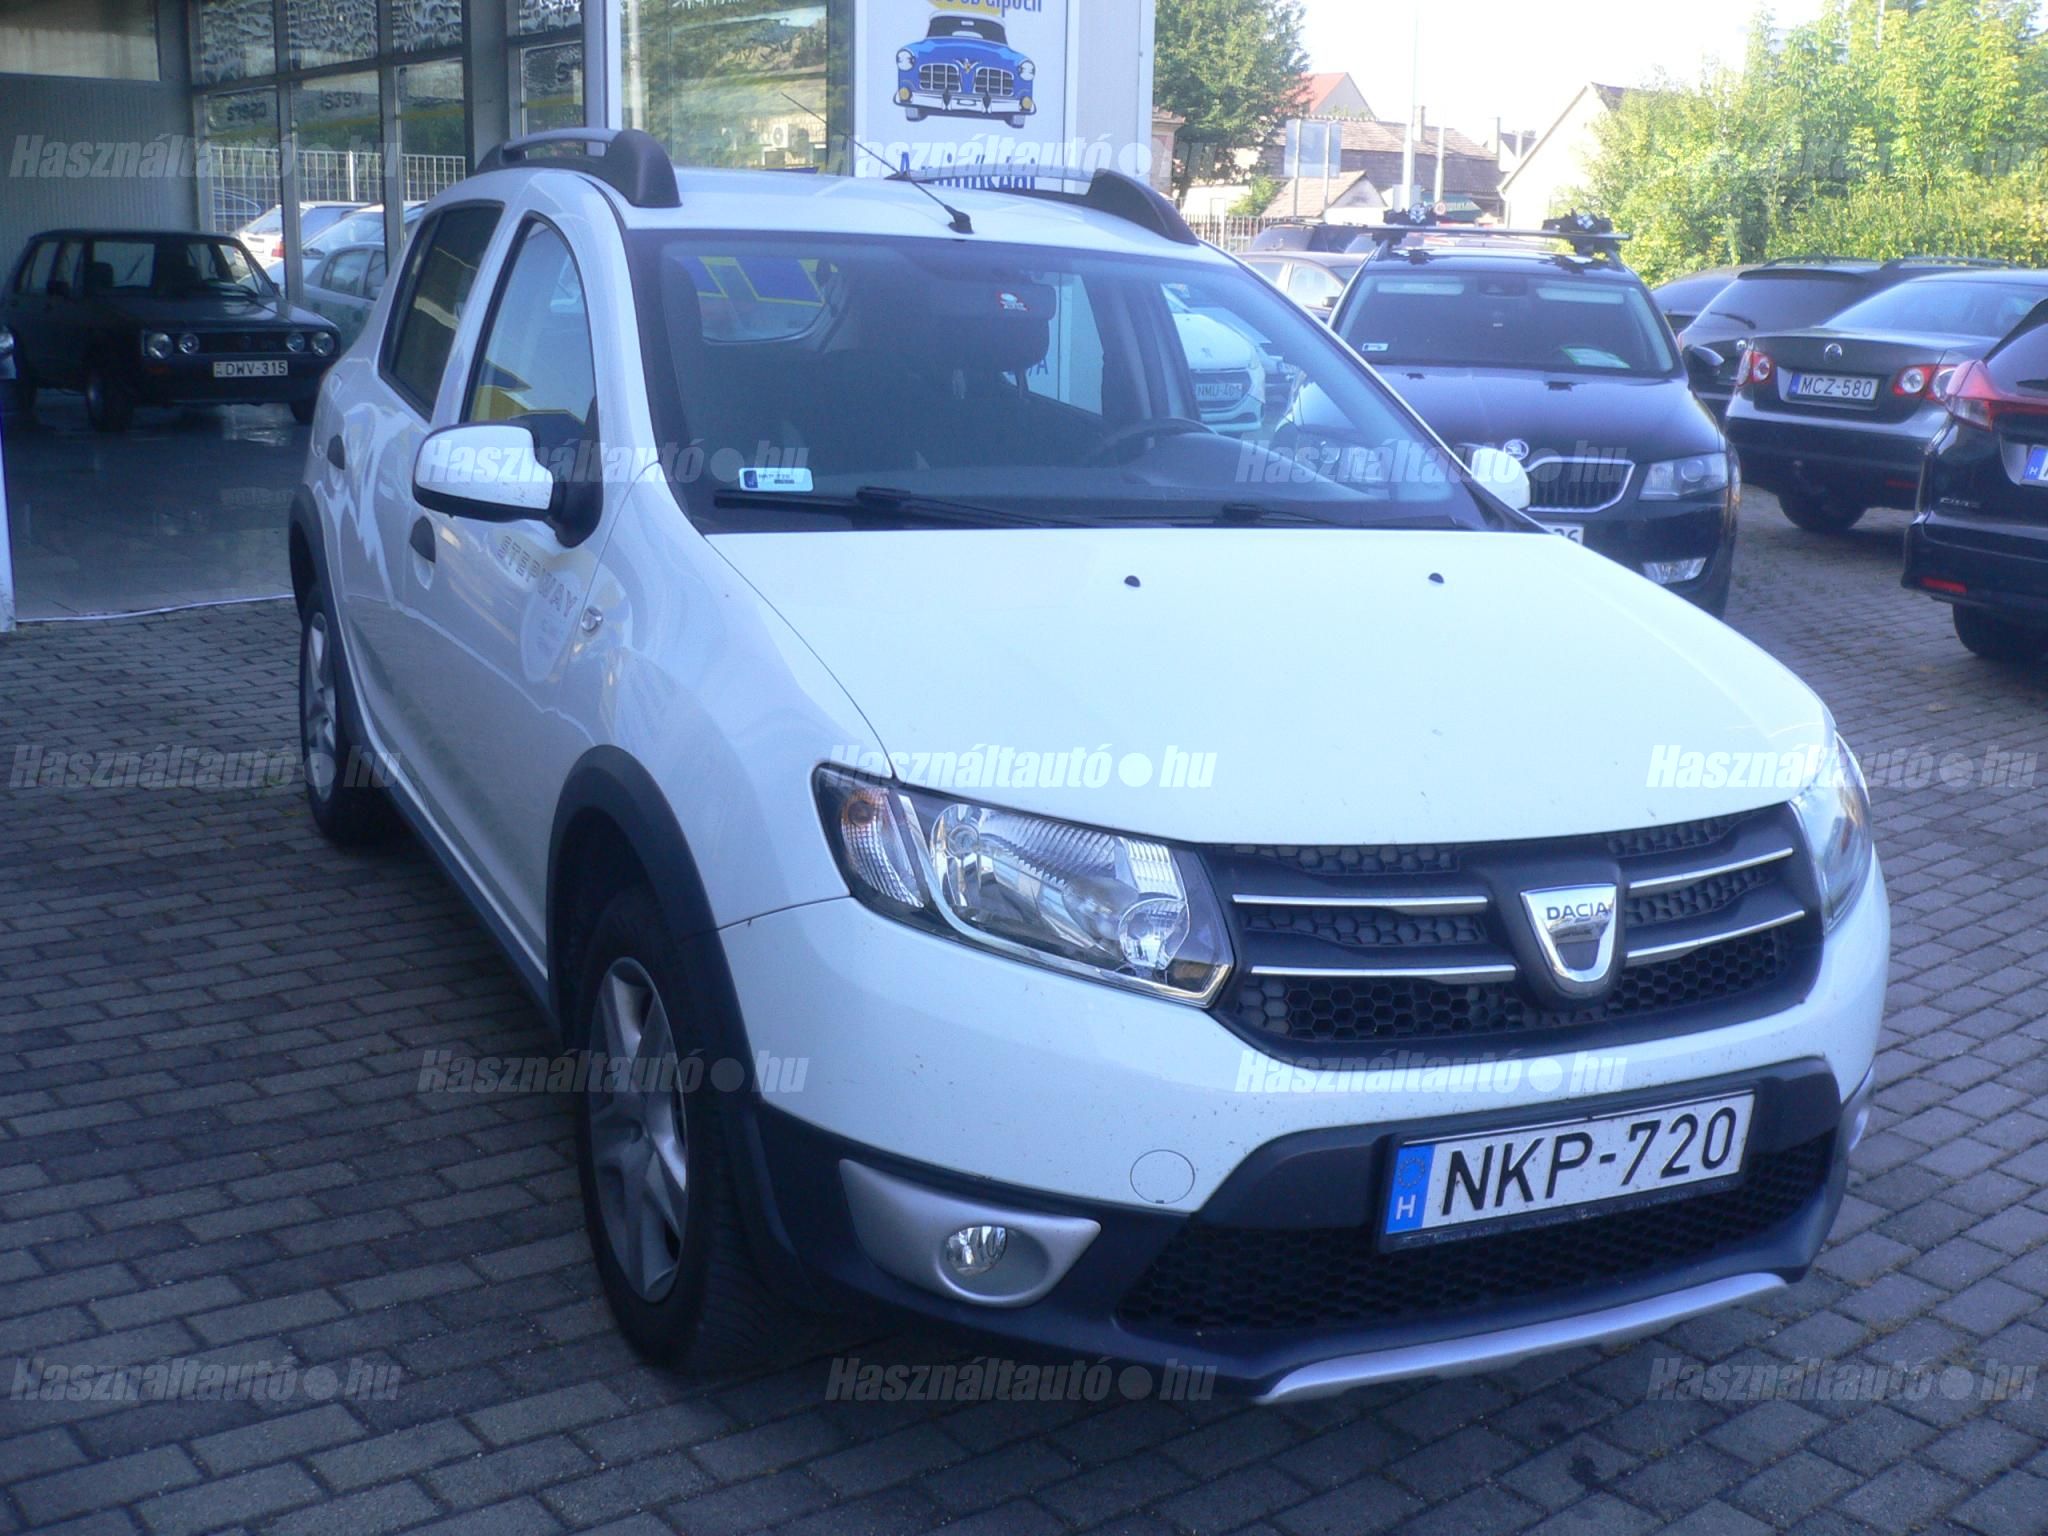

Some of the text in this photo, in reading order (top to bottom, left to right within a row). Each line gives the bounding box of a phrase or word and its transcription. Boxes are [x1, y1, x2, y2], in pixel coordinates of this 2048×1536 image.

[226, 362, 286, 376] DWV-315
[1802, 376, 1873, 398] MCZ-580
[1546, 902, 1608, 920] DACIA
[1441, 1106, 1737, 1216] NKP-720
[1395, 1194, 1416, 1220] H
